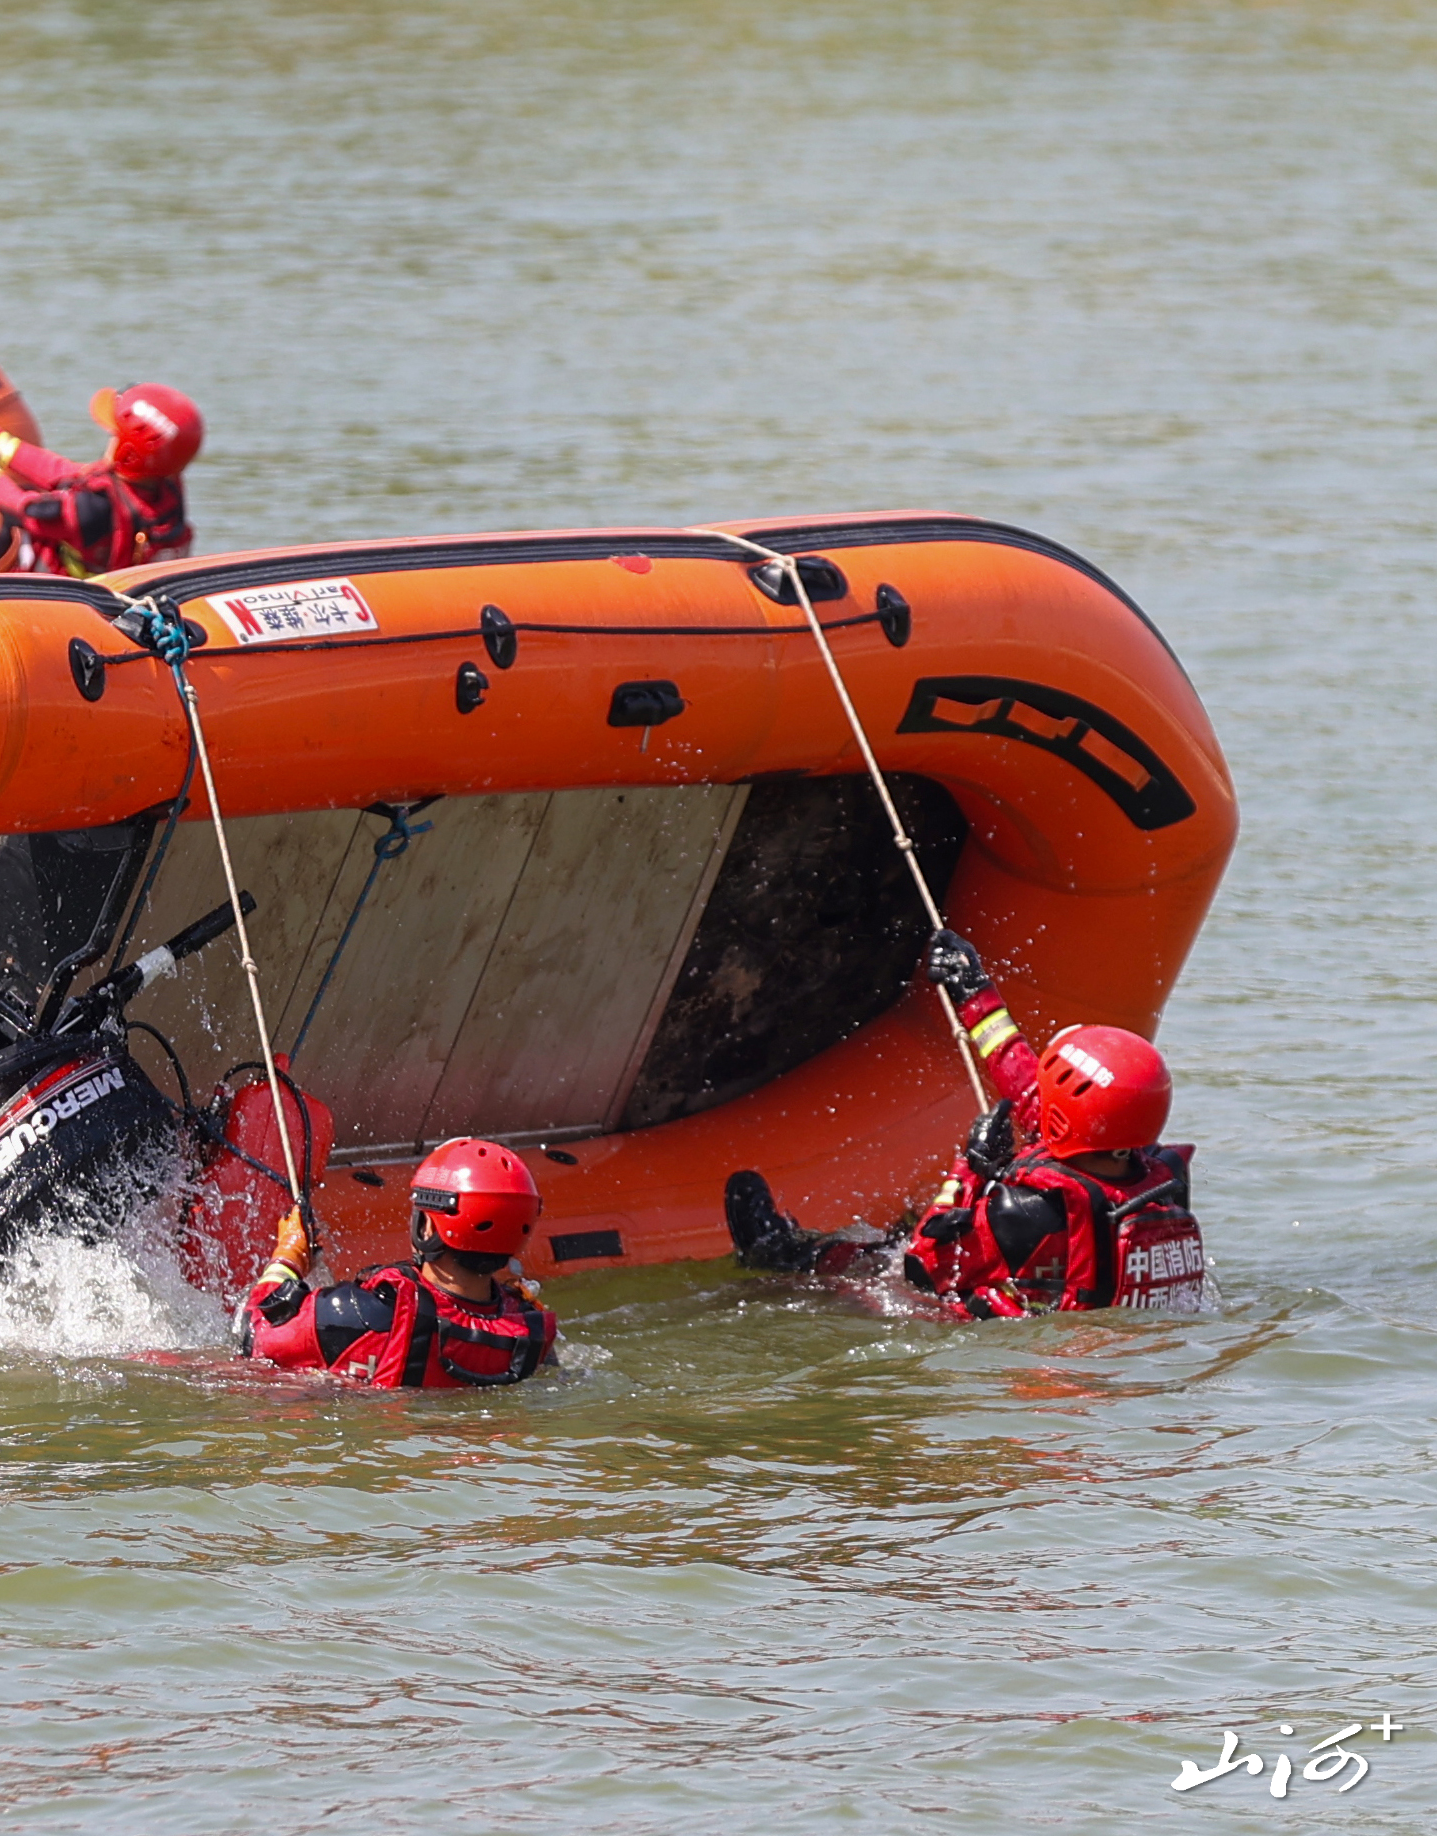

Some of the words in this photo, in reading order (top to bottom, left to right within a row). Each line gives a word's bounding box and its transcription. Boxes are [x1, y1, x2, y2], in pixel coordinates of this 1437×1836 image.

[1126, 1236, 1203, 1283] 中国消防
[1121, 1279, 1201, 1309] 山西
